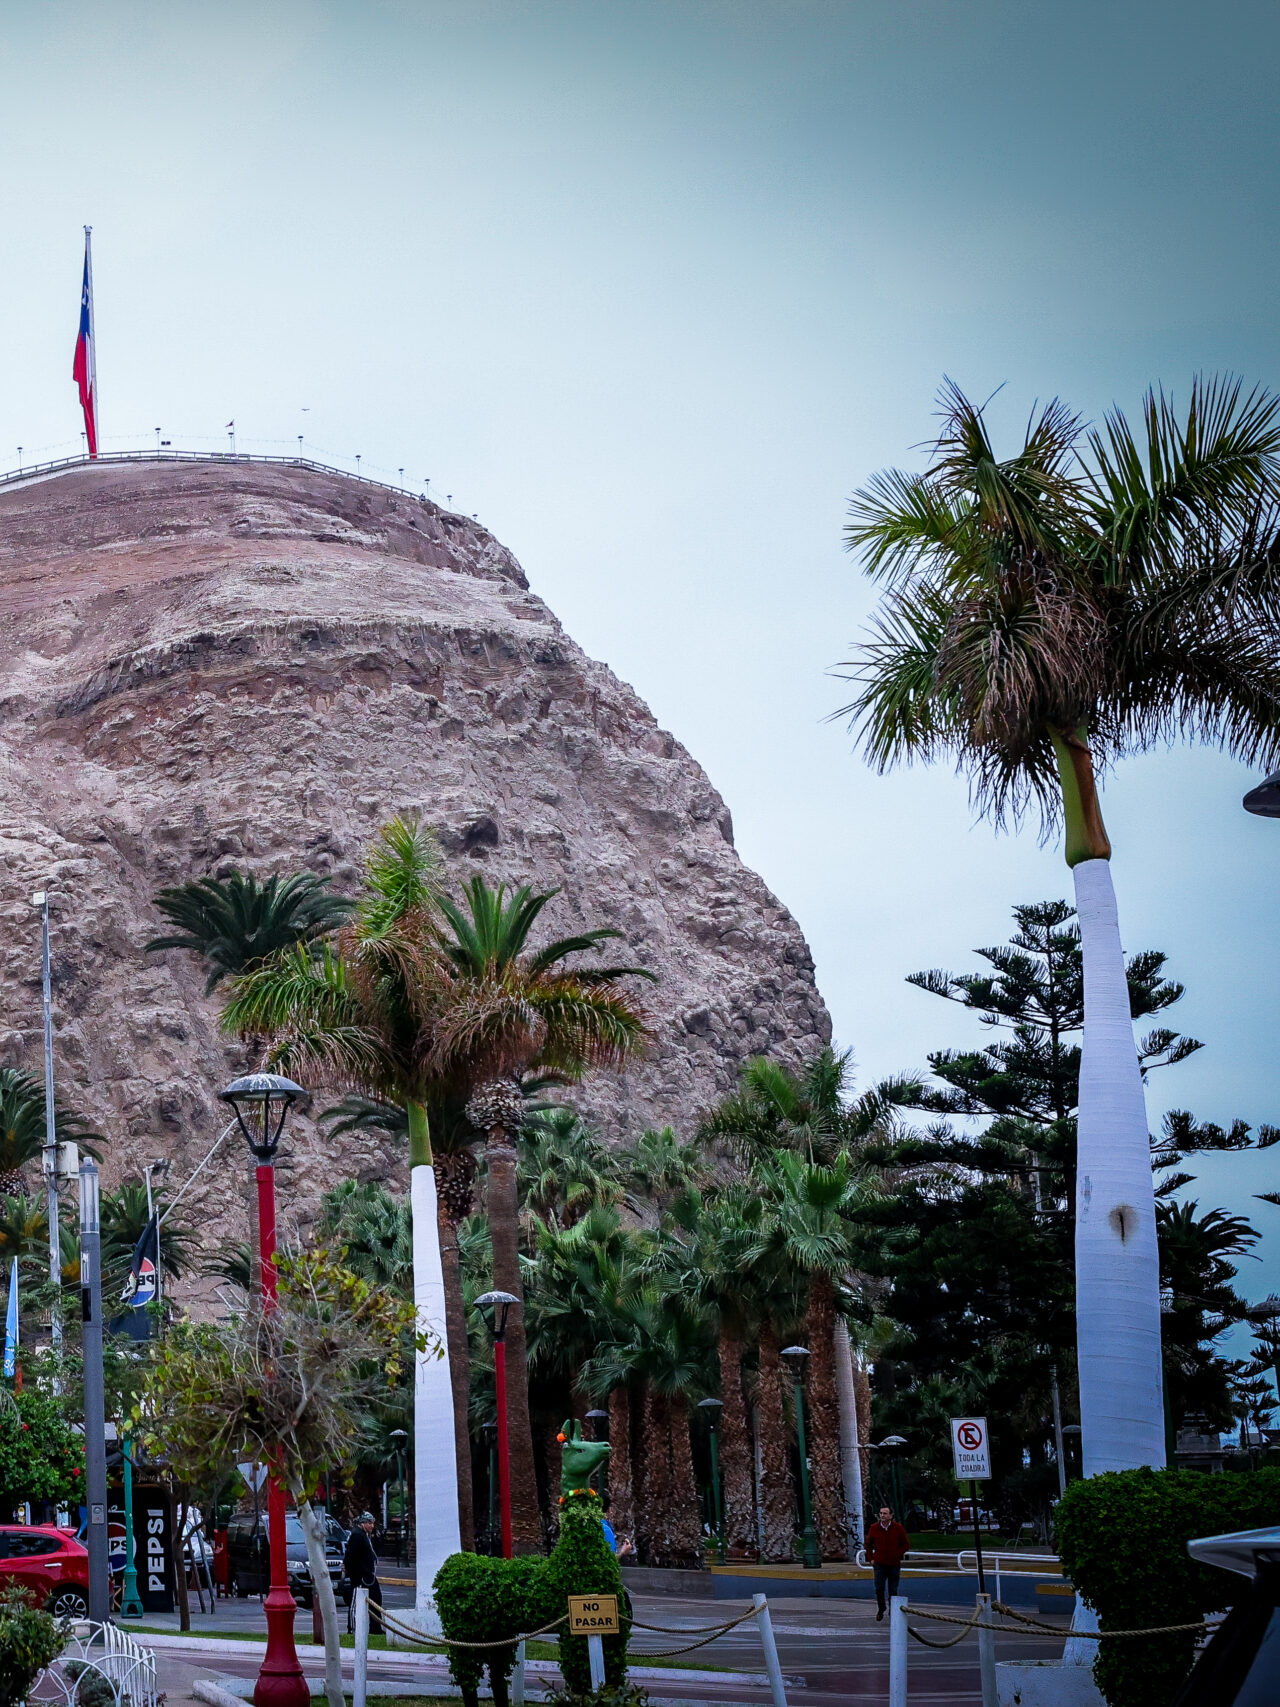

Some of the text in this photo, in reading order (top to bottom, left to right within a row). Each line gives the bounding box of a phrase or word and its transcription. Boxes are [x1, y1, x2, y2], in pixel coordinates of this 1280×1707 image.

[958, 1453, 985, 1462] TODA LA
[961, 1464, 986, 1473] CUADRA
[147, 1509, 166, 1592] PEPSI
[583, 1602, 600, 1612] NO
[575, 1617, 613, 1627] PASAR
